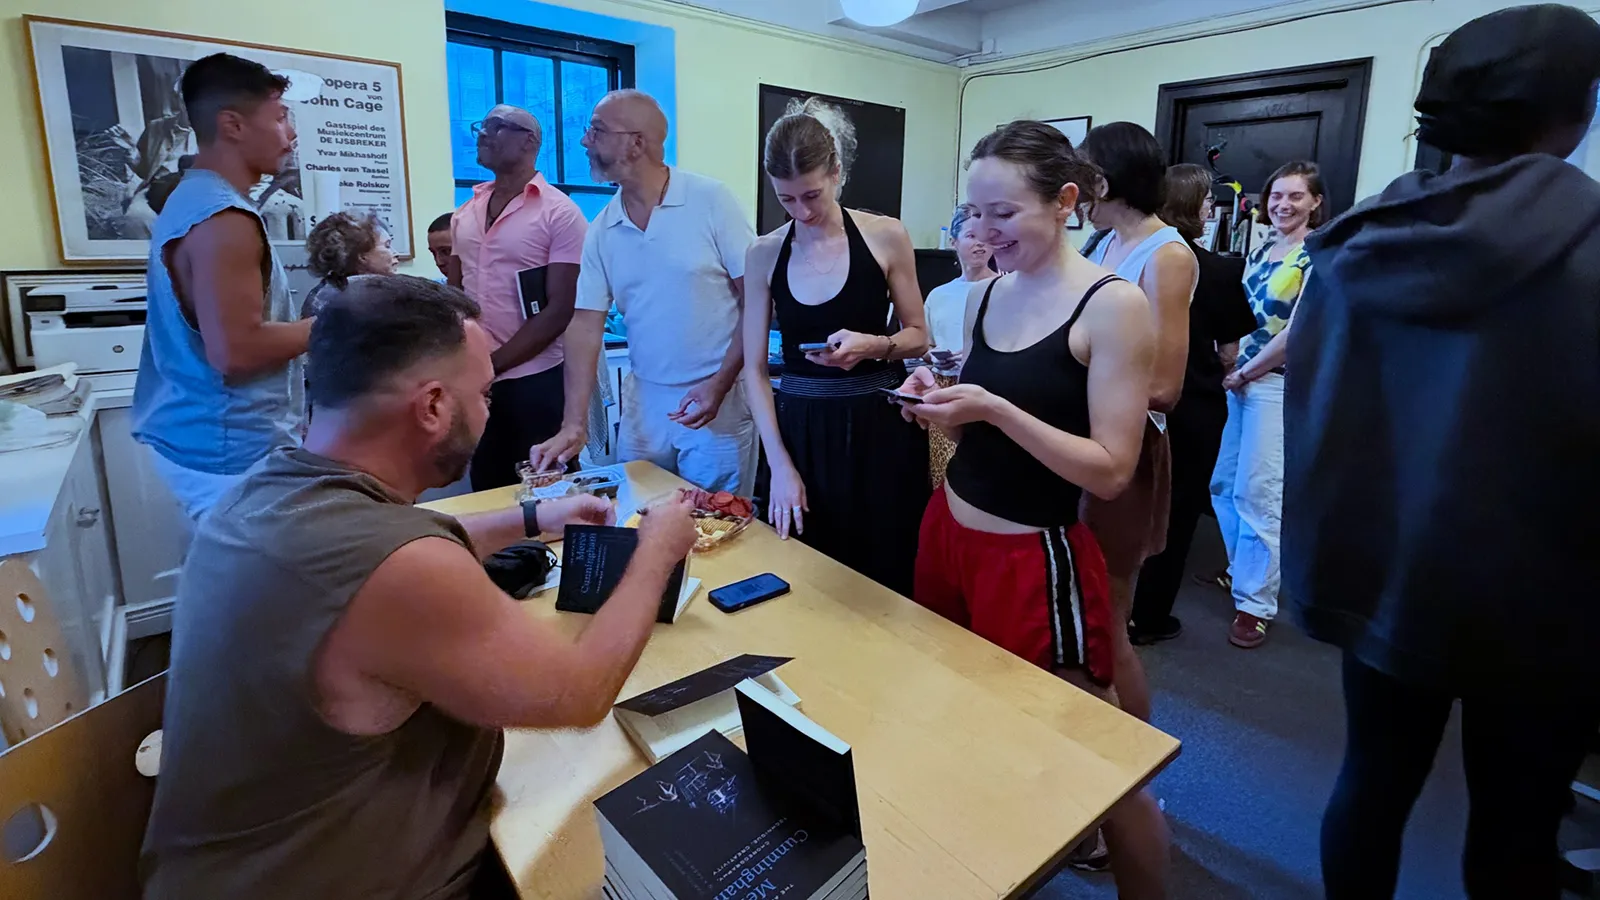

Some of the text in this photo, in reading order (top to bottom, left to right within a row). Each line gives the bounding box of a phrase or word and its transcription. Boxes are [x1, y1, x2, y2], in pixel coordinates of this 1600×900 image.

[322, 78, 382, 92] opera 5
[300, 94, 383, 112] ohn Cage
[325, 121, 368, 131] Gastspiel
[317, 128, 387, 139] Musiekcentrum
[320, 136, 387, 148] DE IJSBREKER
[316, 149, 388, 160] Yvar Mikhashoff
[305, 163, 341, 173] Charles
[361, 166, 389, 175] Tassel
[580, 532, 597, 595] Cunningham
[712, 845, 751, 876] CREATIVITY
[741, 878, 778, 900] Me
